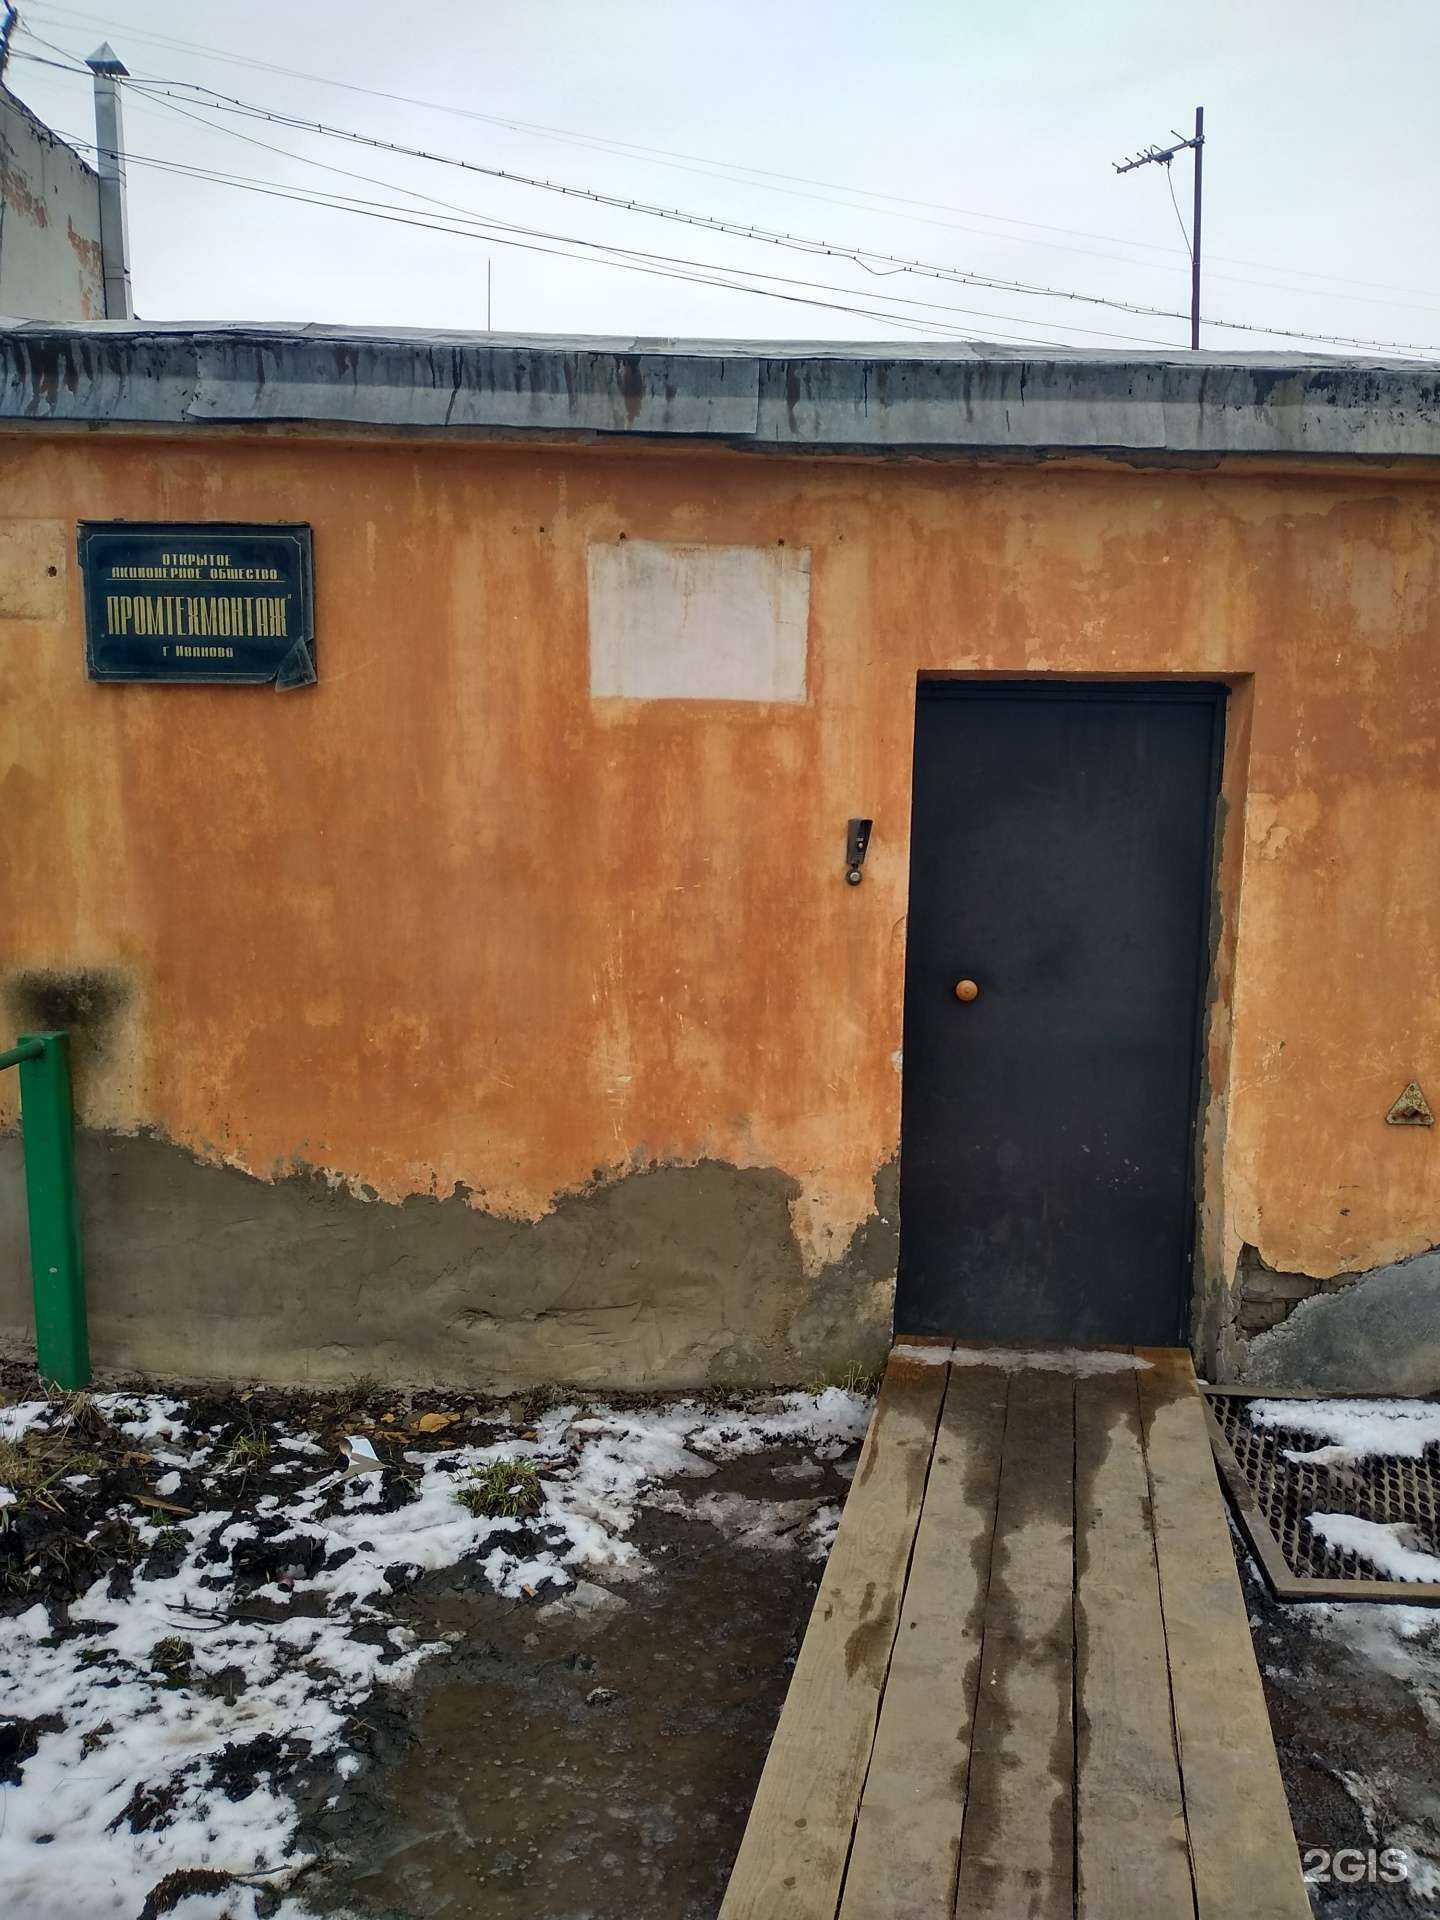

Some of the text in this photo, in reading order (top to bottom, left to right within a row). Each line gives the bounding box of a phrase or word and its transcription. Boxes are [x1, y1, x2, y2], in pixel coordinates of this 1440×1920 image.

[162, 553, 232, 565] ОТКРЫТОЕ
[112, 567, 278, 581] АКЦИОНЕРНОЕ ОБЩЕСТВО
